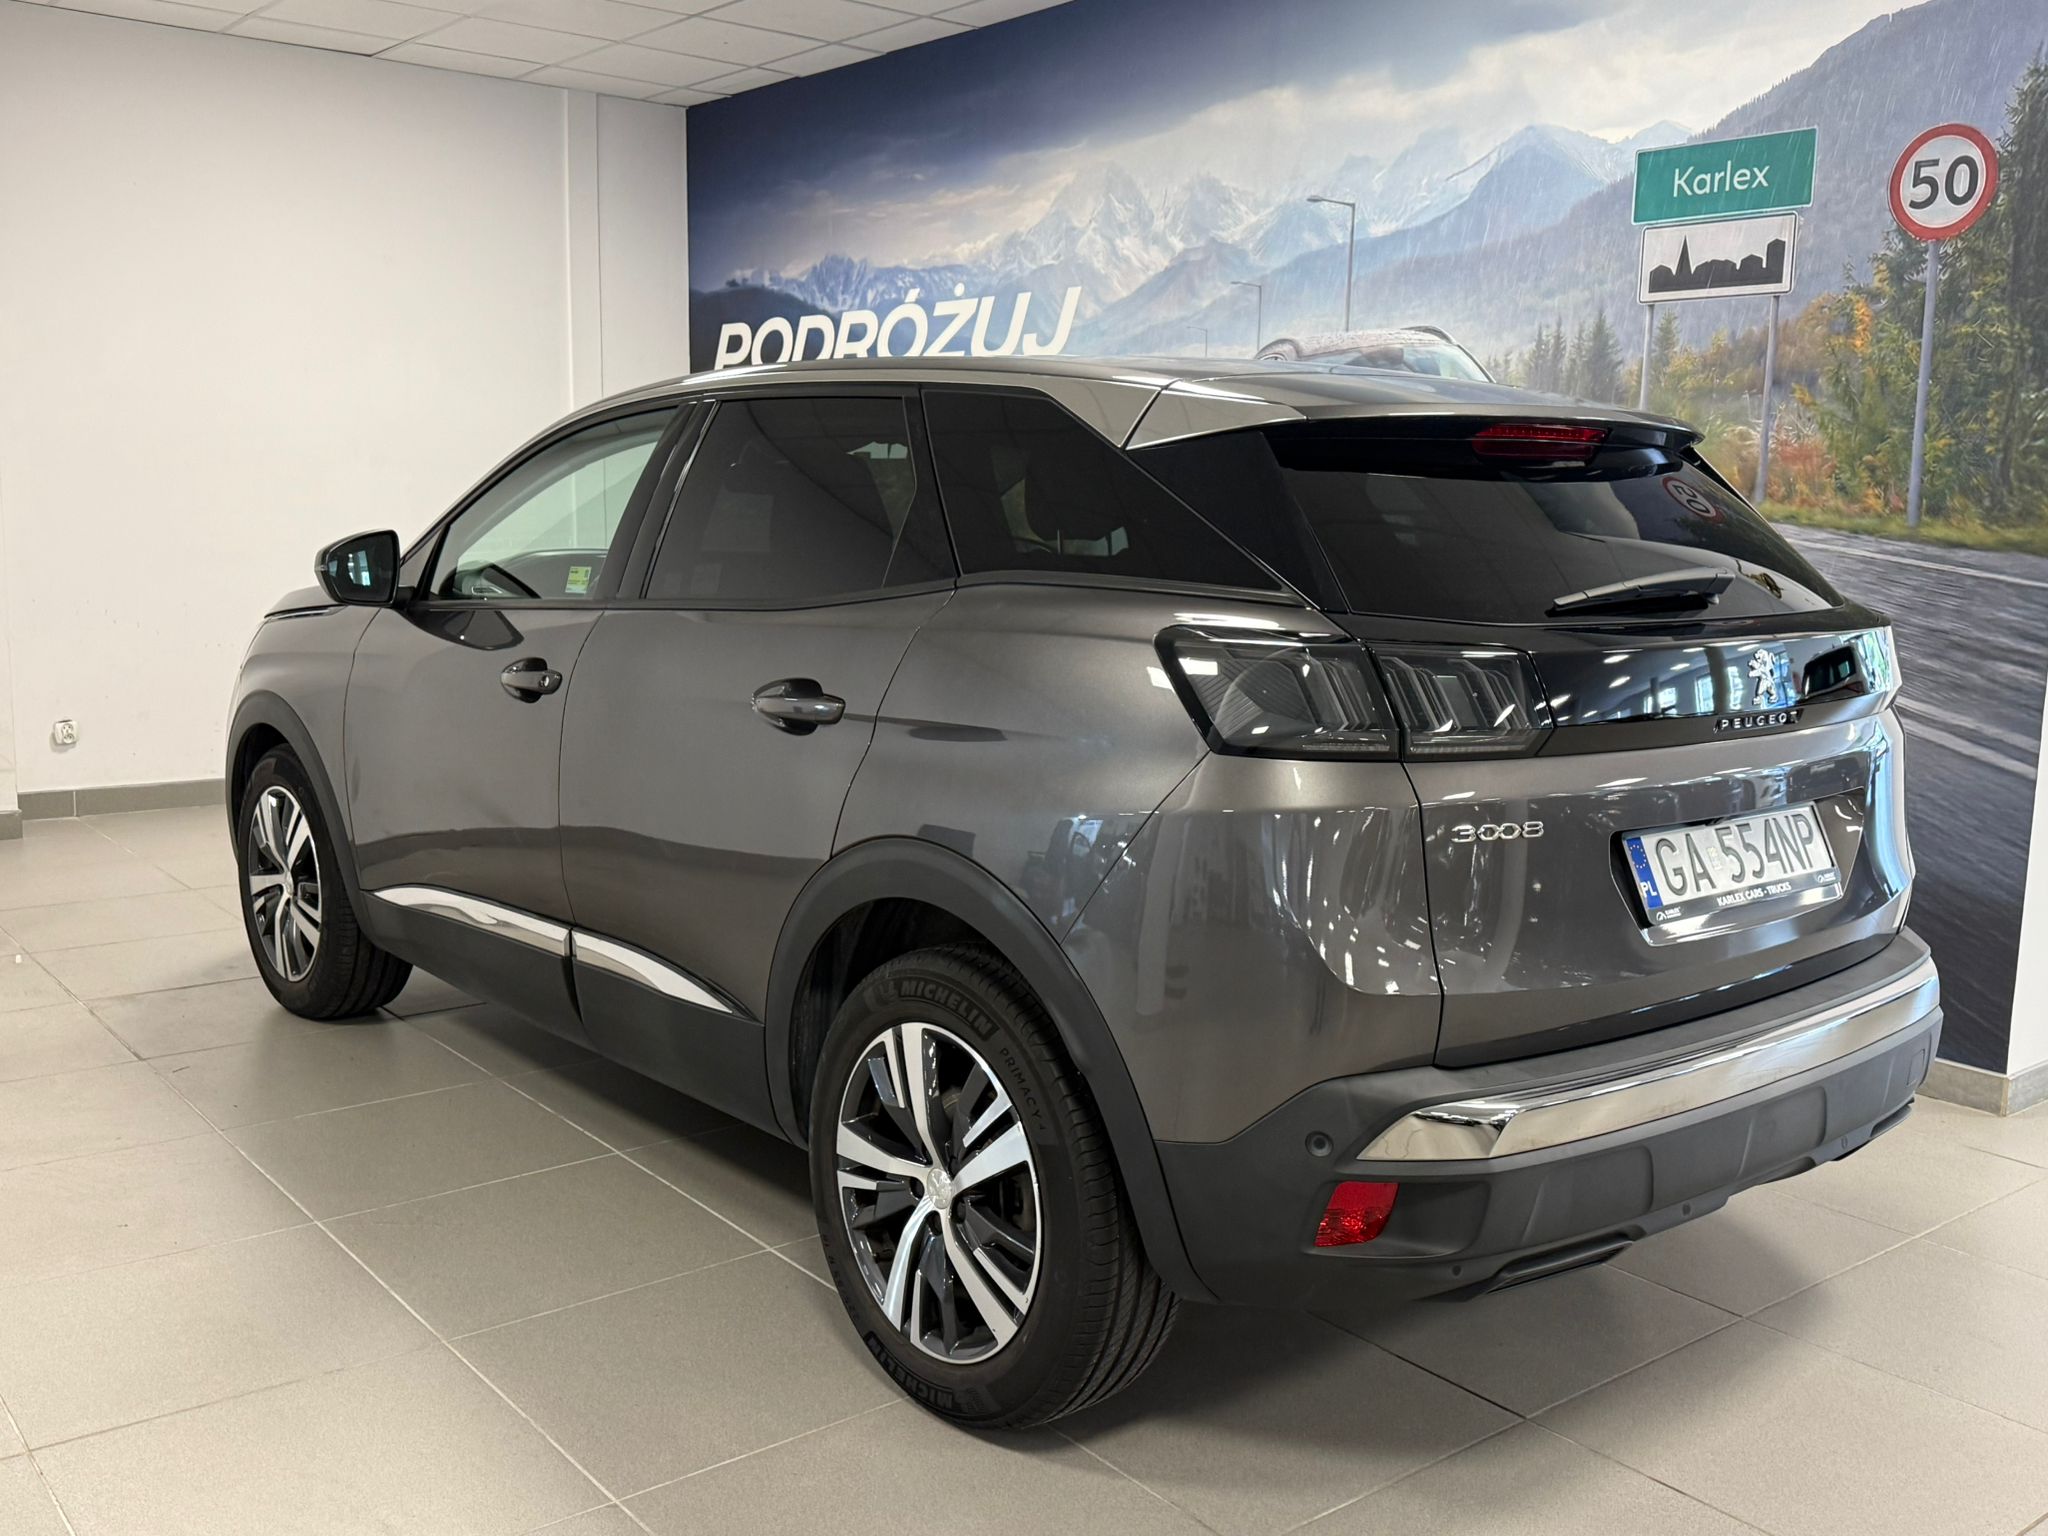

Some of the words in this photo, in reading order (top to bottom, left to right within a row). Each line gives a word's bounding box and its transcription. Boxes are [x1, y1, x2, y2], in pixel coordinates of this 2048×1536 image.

[1673, 160, 1771, 198] Karlex
[1908, 155, 1980, 210] 50
[714, 283, 1082, 371] PODRÓŻUJ
[1720, 710, 1800, 730] PEUGEOT
[1451, 821, 1544, 842] 3008
[1655, 833, 1716, 896] GA
[1714, 814, 1815, 884] 554NP
[1640, 881, 1657, 898] PL
[1716, 893, 1746, 907] KARLEX
[1745, 889, 1764, 901] CARS
[1767, 882, 1792, 896] TRUCKS
[901, 980, 993, 1036] MICHELIN
[1000, 1047, 1042, 1119] PRIMACY
